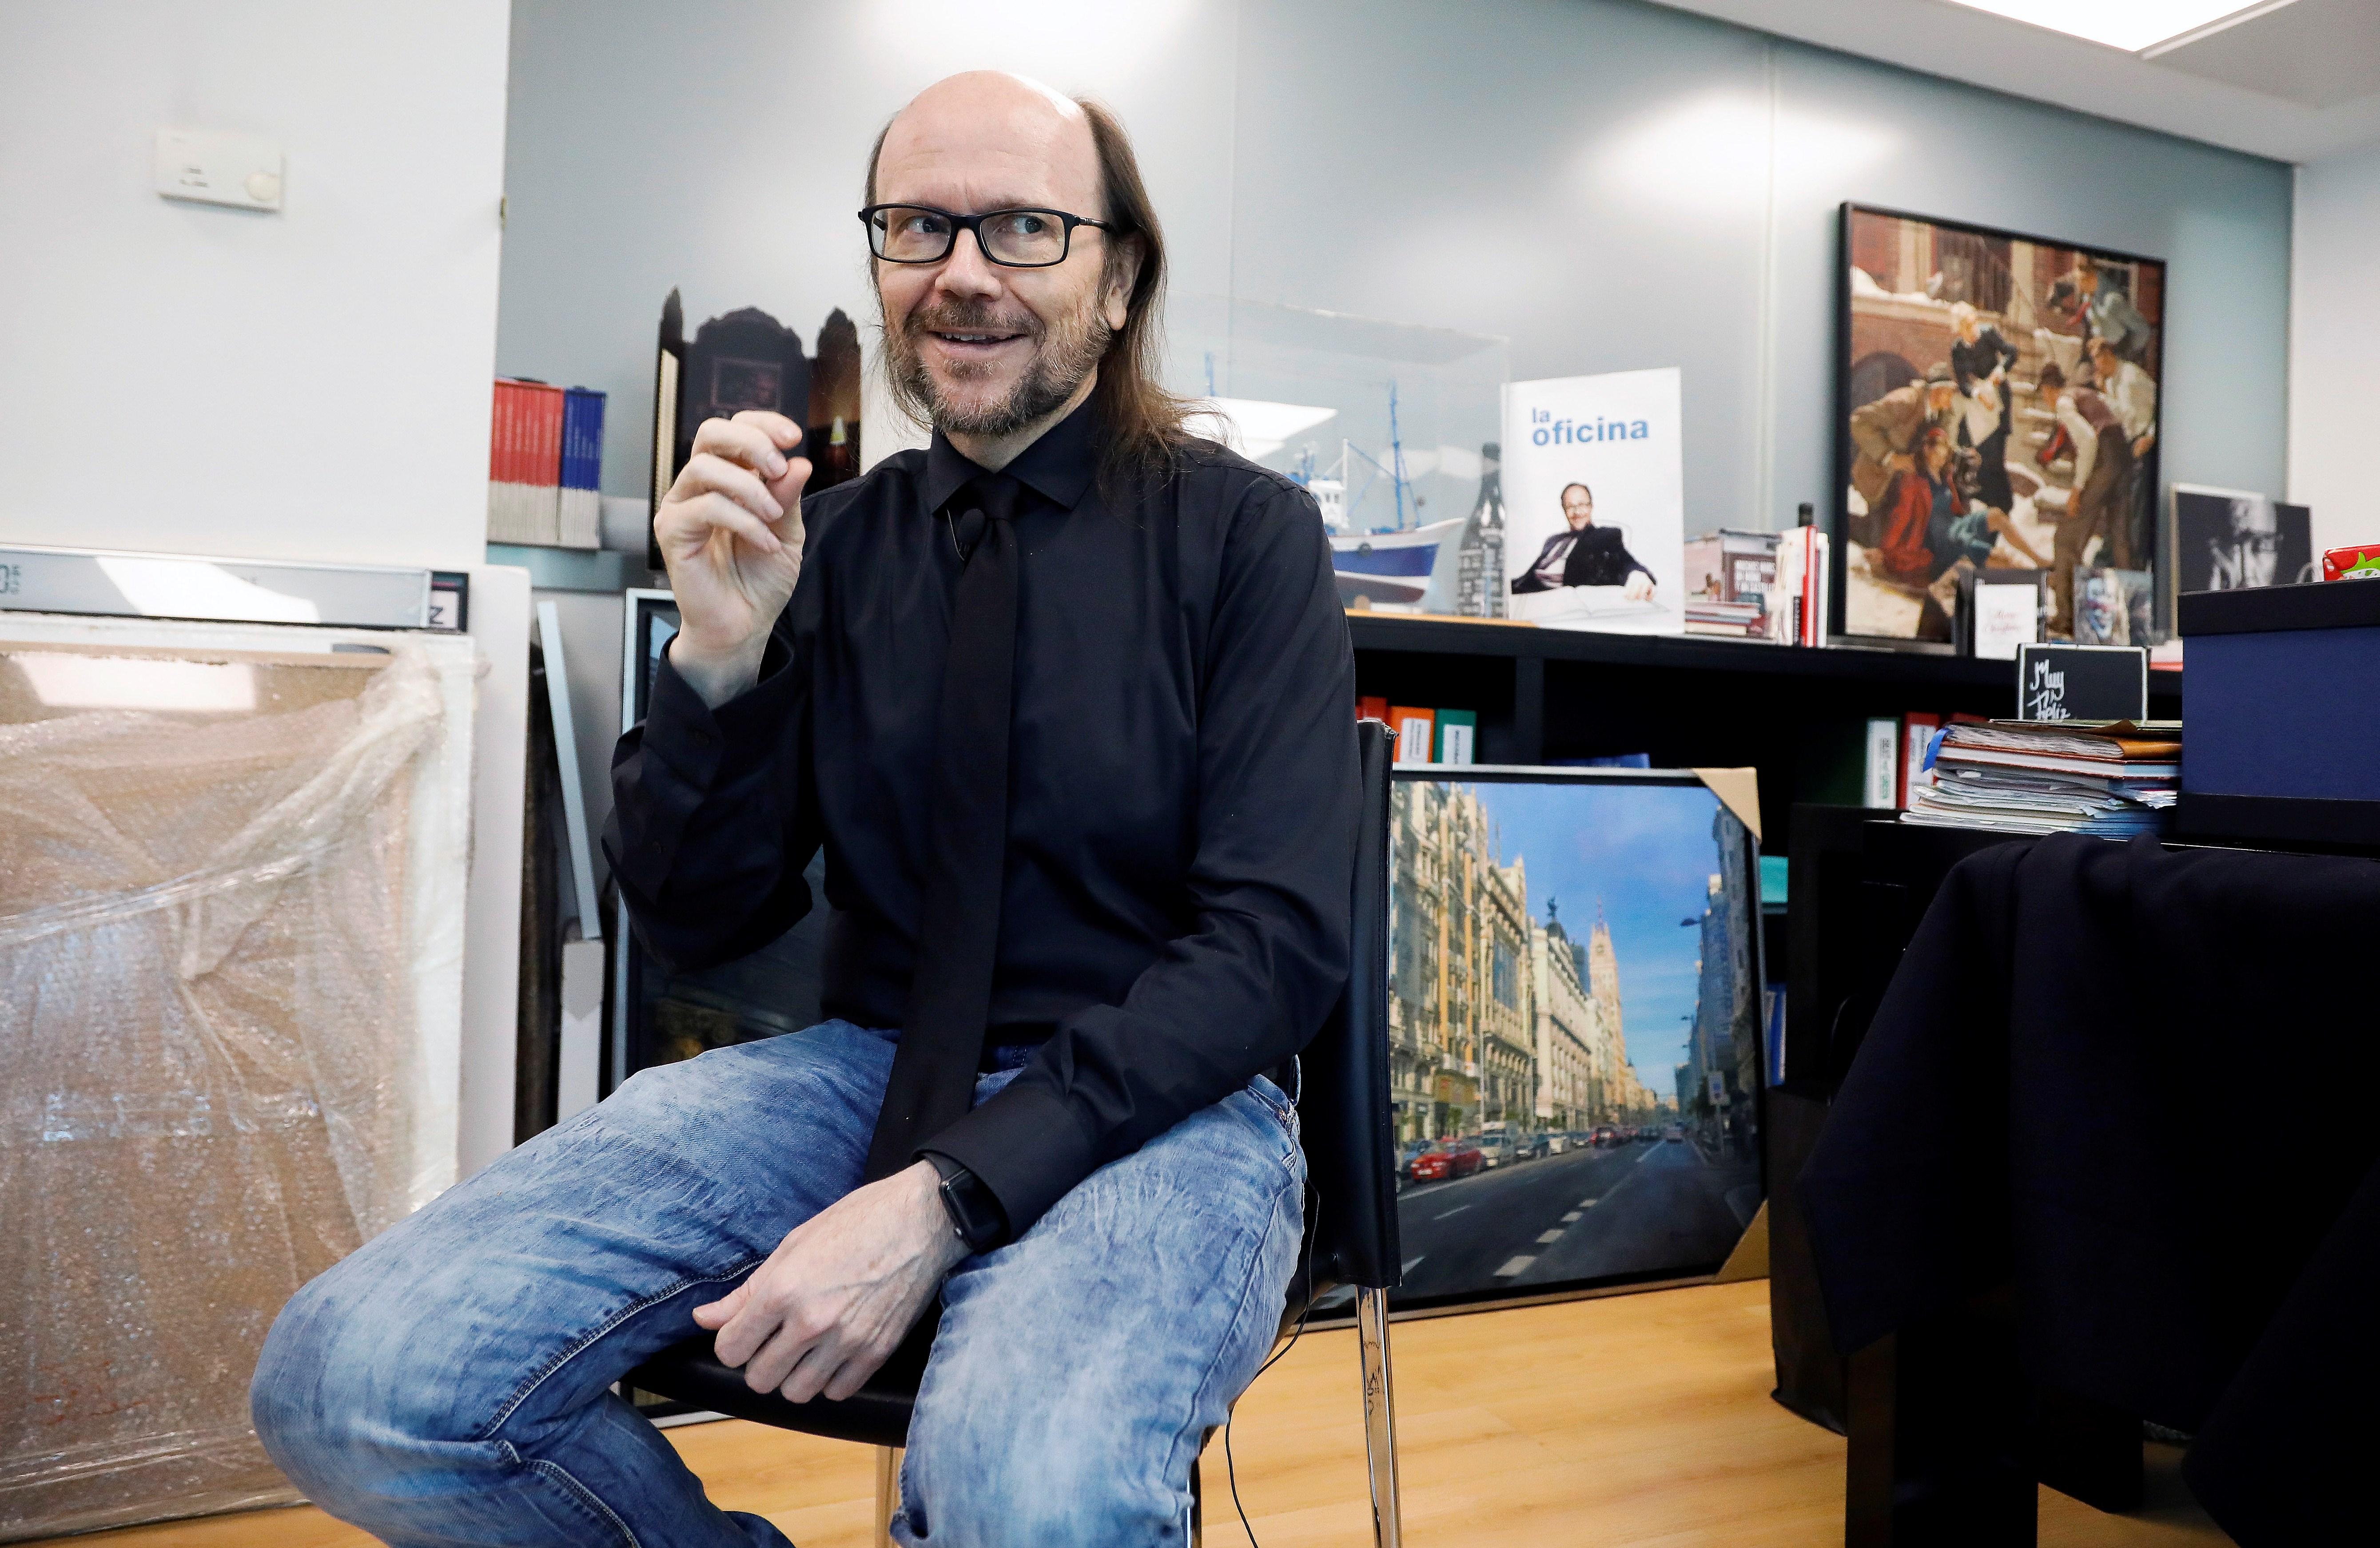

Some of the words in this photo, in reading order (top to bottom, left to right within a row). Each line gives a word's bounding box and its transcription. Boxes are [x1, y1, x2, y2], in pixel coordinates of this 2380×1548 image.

[1532, 407, 1550, 422] la
[1532, 416, 1648, 446] oficina
[2029, 659, 2065, 702] Muy
